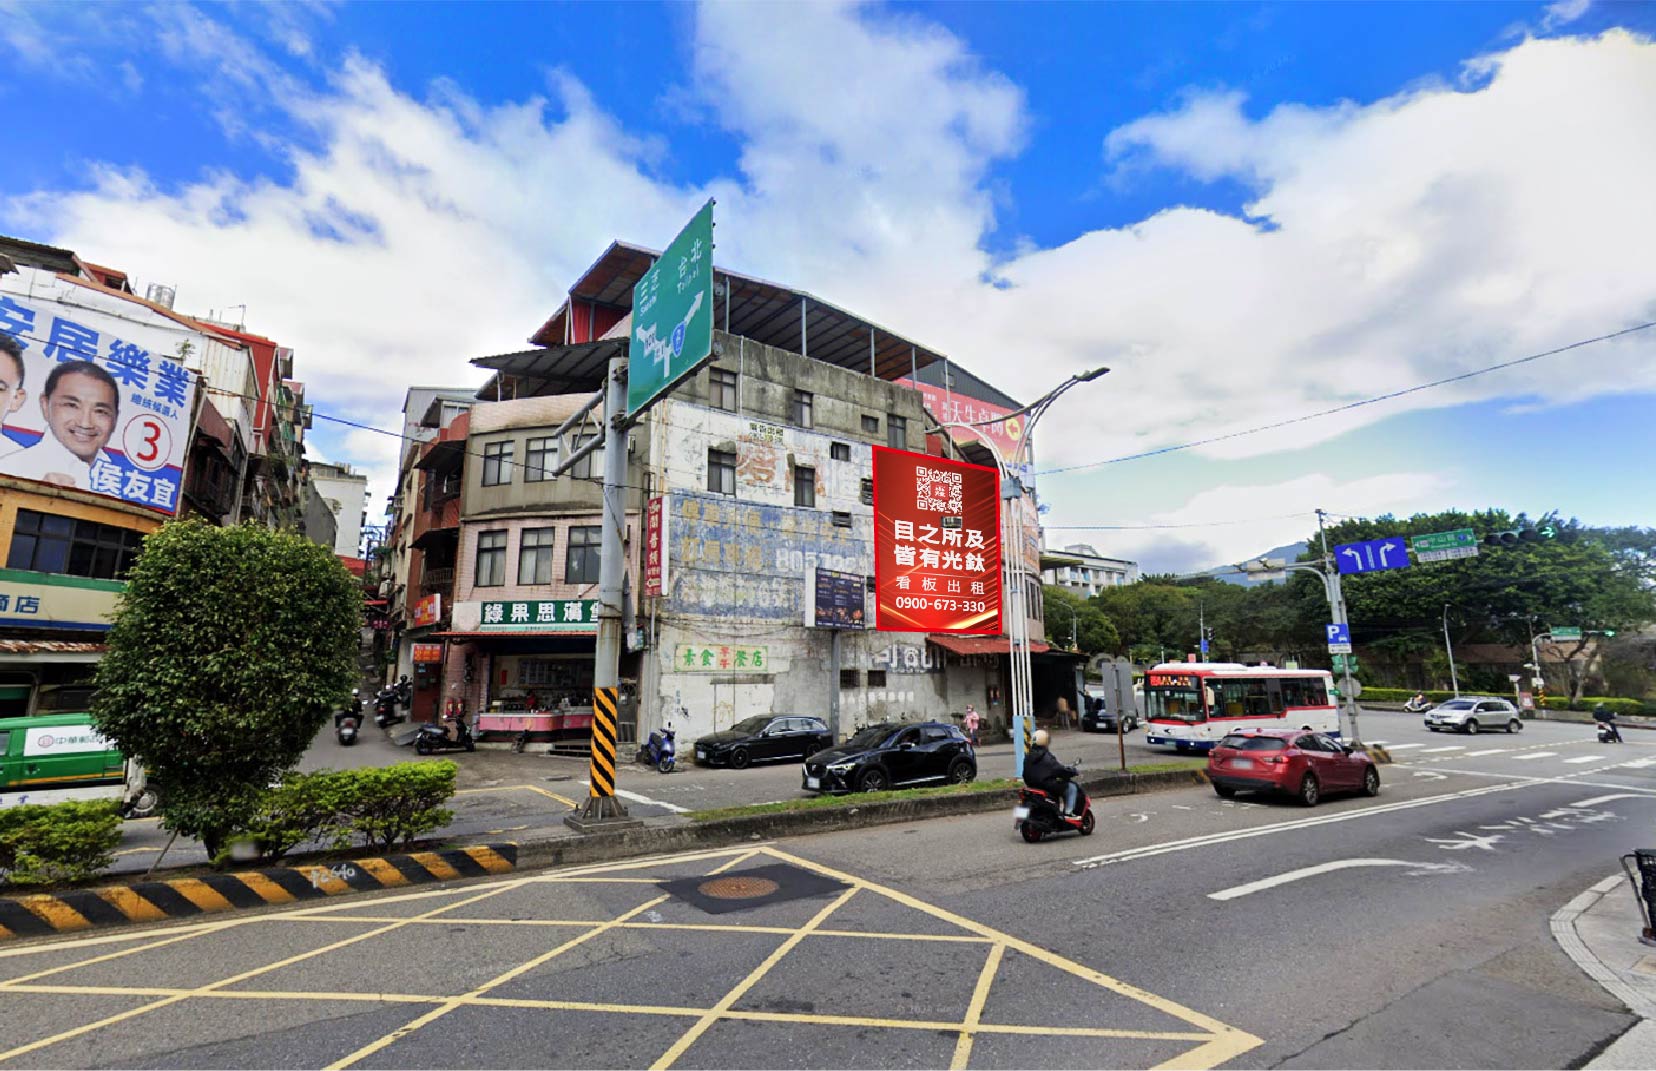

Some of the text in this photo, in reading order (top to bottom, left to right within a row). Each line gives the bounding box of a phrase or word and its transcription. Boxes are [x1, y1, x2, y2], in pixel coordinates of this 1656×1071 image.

[137, 421, 161, 461] 3
[92, 461, 176, 507] 侯友宜
[894, 519, 985, 549] 目之所及
[893, 545, 986, 573] 皆有光鈦
[895, 576, 985, 595] 看板出租
[895, 596, 986, 613] 0900-673-330
[1327, 625, 1340, 639] P
